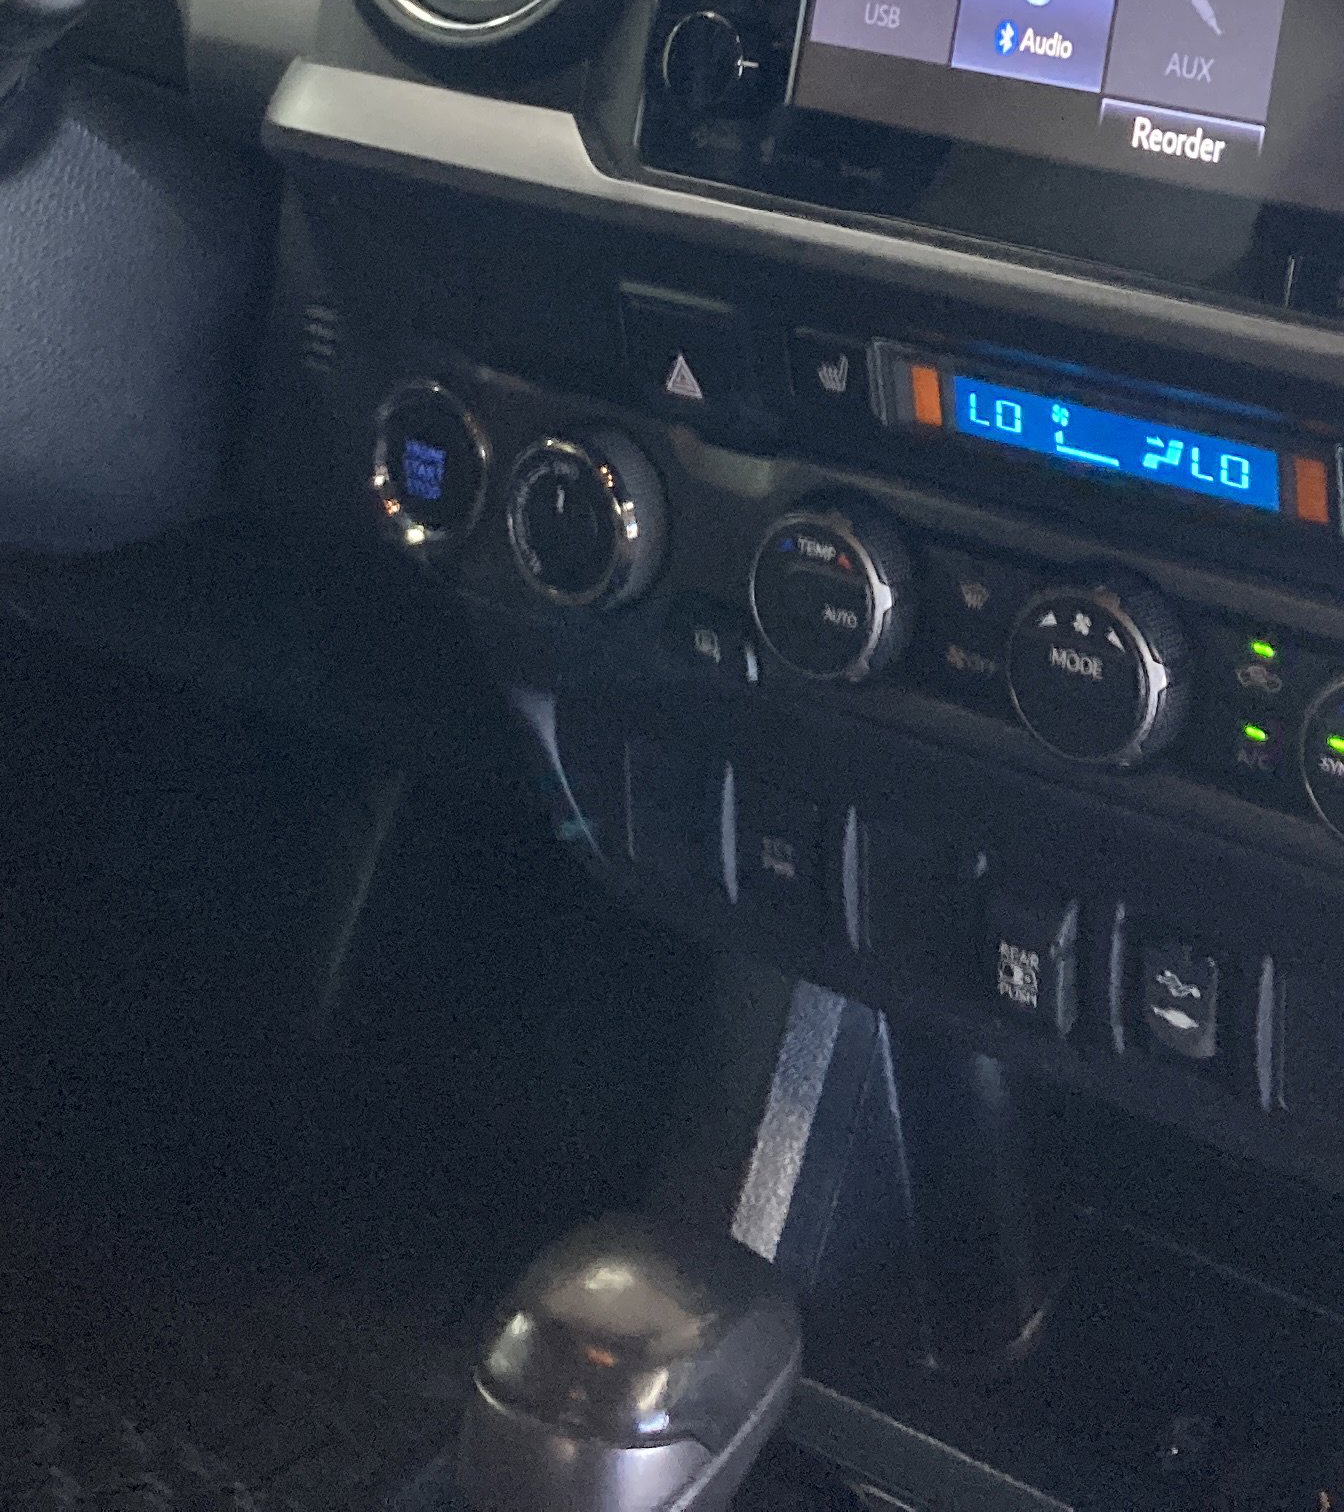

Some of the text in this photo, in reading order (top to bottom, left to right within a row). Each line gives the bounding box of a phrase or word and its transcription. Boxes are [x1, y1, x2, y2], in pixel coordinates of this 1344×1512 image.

[864, 2, 901, 29] USB
[1019, 27, 1073, 60] Audio
[1164, 52, 1215, 83] AUX
[1131, 116, 1226, 164] Reorder
[797, 536, 837, 561] TEMP
[823, 603, 858, 629] AUTO
[1049, 645, 1103, 681] MODE
